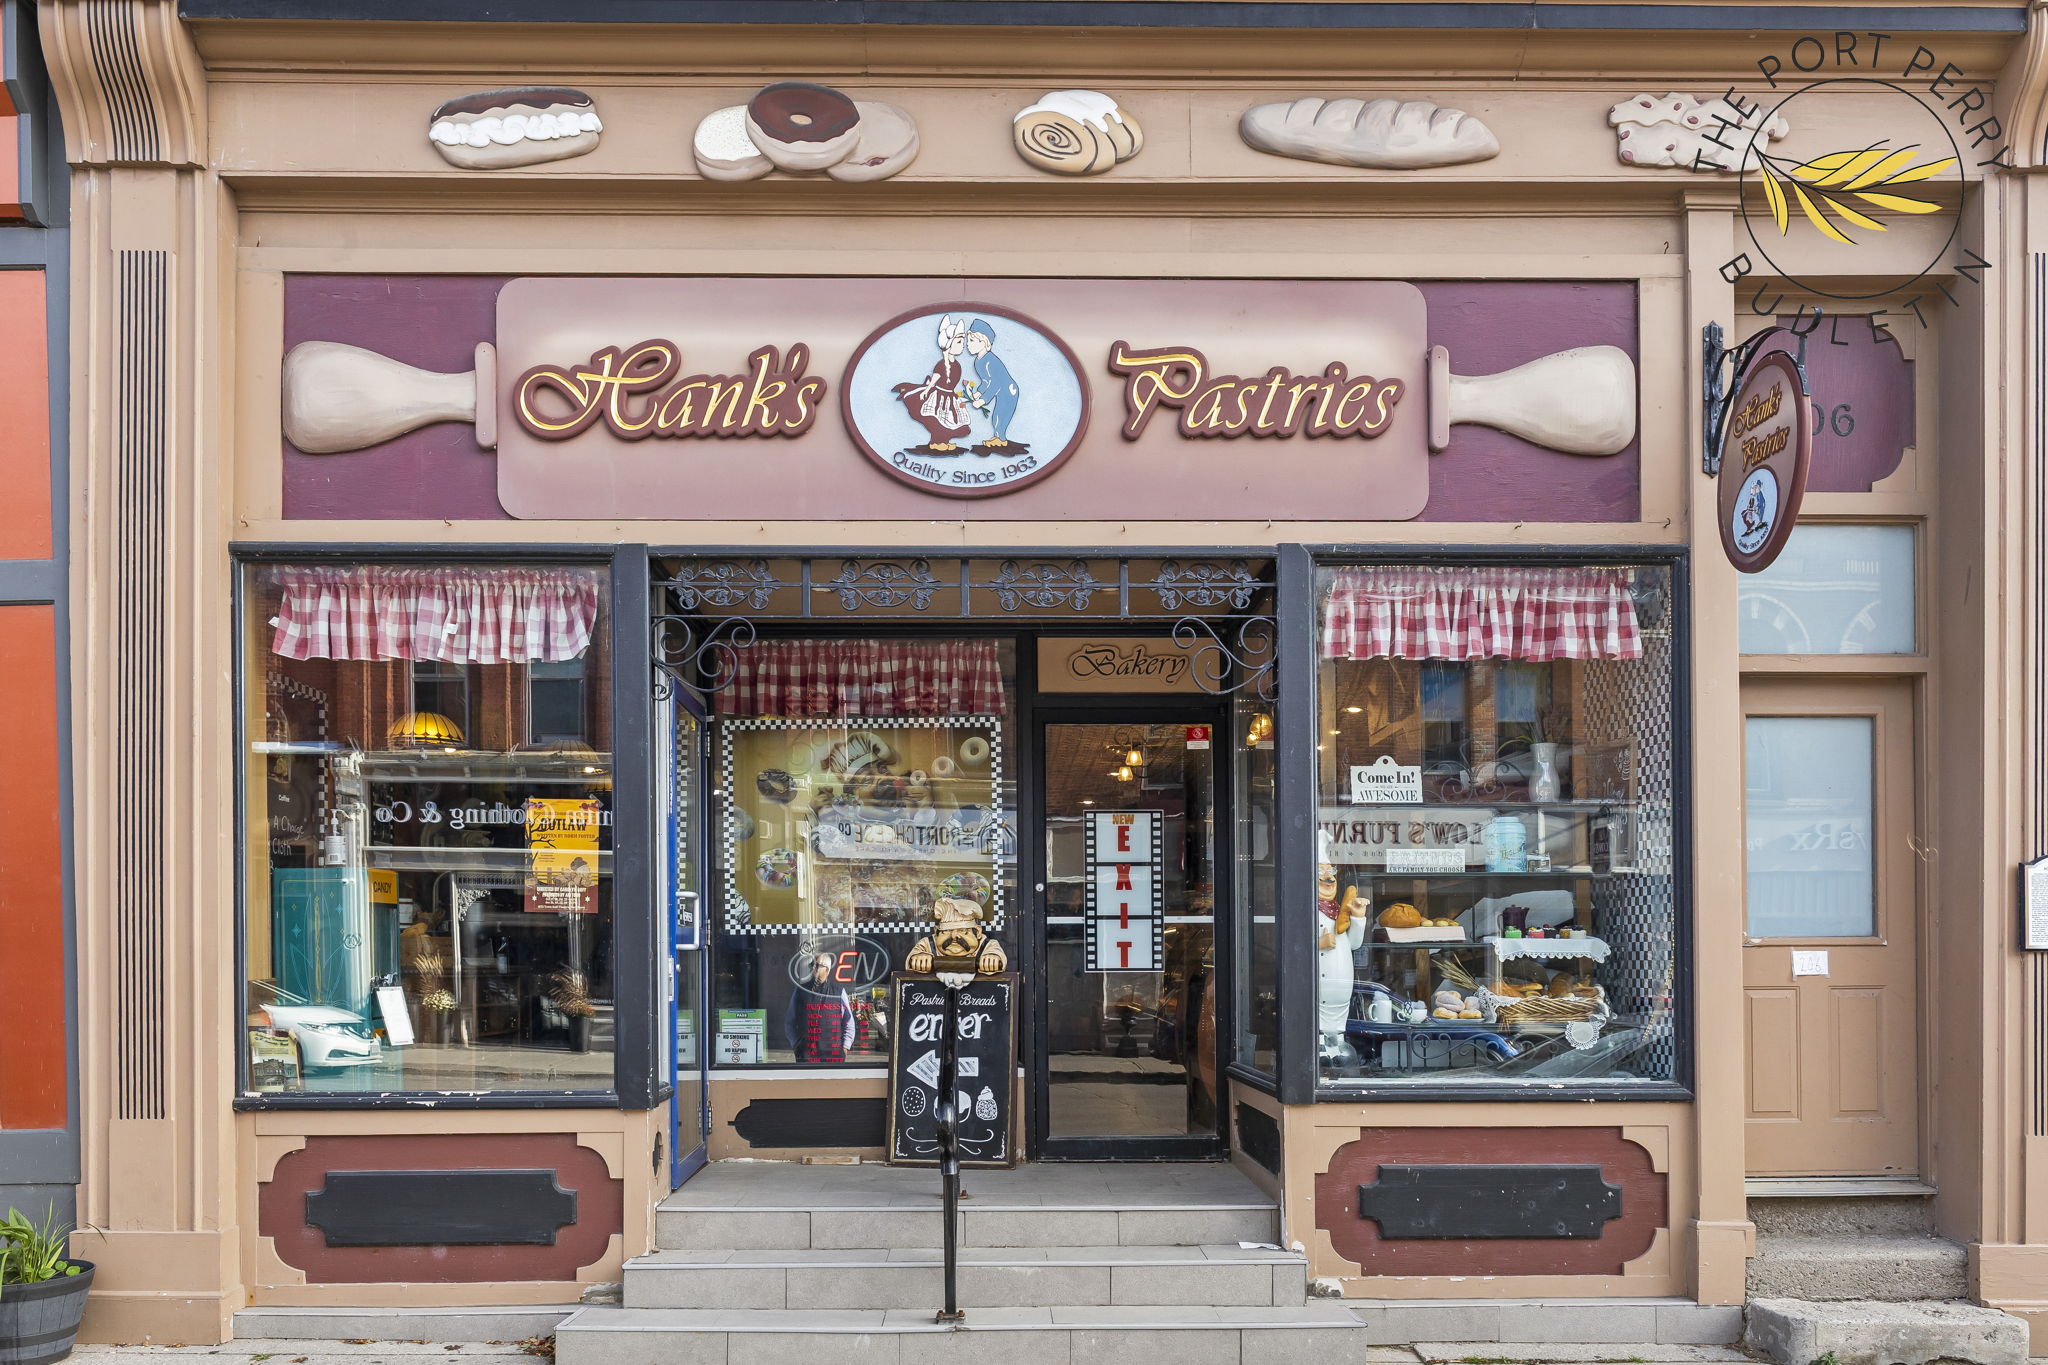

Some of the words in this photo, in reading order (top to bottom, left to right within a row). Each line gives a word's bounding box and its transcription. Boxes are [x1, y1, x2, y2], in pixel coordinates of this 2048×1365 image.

[517, 342, 821, 435] Hank's
[1112, 344, 1401, 435] Pastries
[1733, 382, 1782, 438] Hank's
[1811, 402, 1855, 437] 06
[1742, 425, 1790, 472] Pastries
[892, 450, 946, 482] Quality
[952, 470, 995, 484] Since
[1000, 455, 1037, 479] 1963
[1071, 648, 1186, 683] Bakery
[1357, 771, 1395, 784] Come
[1396, 771, 1415, 784] In!
[1358, 790, 1418, 801] AWESOME
[539, 818, 587, 831] OUTLAW
[1112, 814, 1135, 824] NEW
[373, 881, 392, 894] CANDY
[1116, 826, 1133, 967] EXIT
[806, 1003, 841, 1011] BUSINESS
[959, 993, 997, 1006] Breads
